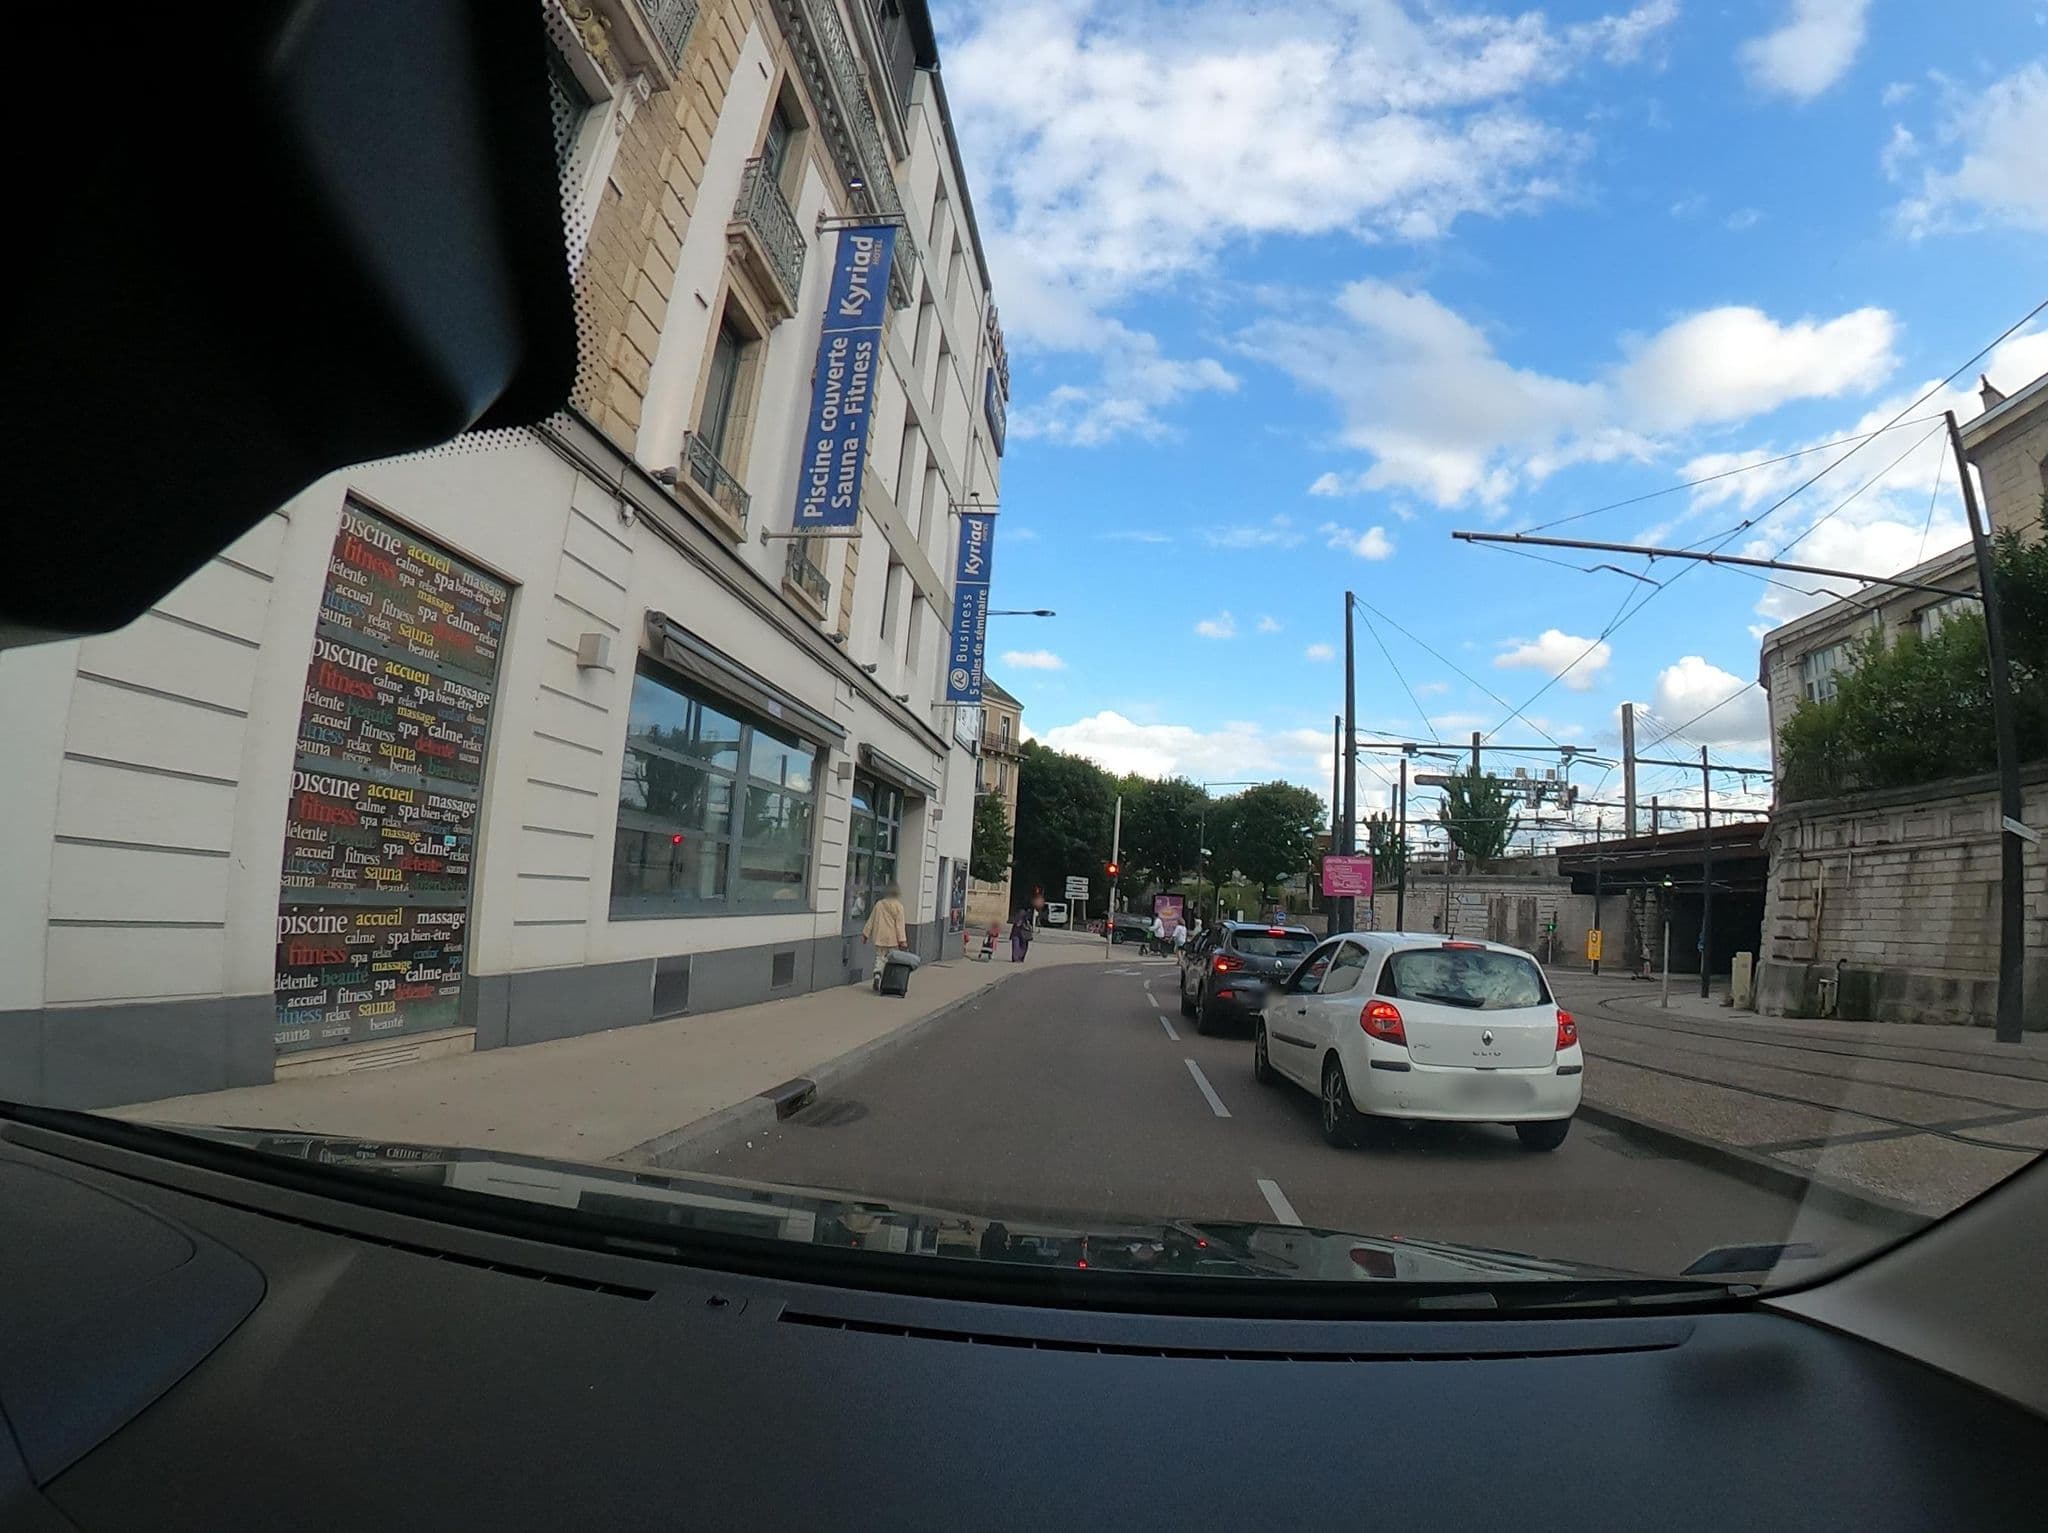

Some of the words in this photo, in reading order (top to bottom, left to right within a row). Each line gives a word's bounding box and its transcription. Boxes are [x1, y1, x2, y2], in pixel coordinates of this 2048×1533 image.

[840, 235, 874, 315] Kyriad
[844, 341, 873, 415] Fitness
[803, 438, 833, 518] Piscine
[821, 336, 849, 432] couverte
[831, 437, 860, 509] Sauna
[964, 519, 984, 575] Kyriad
[395, 557, 424, 577] calme
[407, 545, 451, 574] accueil
[399, 571, 416, 587] spa
[434, 572, 455, 592] spa
[463, 572, 507, 604] massage
[336, 583, 374, 606] accueil
[456, 577, 491, 607] bien-être
[382, 598, 415, 625] fitness
[417, 590, 455, 614] massage
[367, 613, 392, 632] relax
[418, 605, 438, 622] spa
[974, 589, 987, 641] séminaire
[447, 612, 480, 636] calme
[956, 594, 973, 662] Business
[398, 623, 434, 647] sauna
[408, 639, 440, 661] beauté
[973, 643, 983, 656] de
[319, 662, 374, 700] fitness
[385, 661, 430, 685] accueil
[971, 658, 981, 687] salles
[373, 674, 404, 692] calme
[969, 688, 979, 696] 5
[377, 691, 394, 706] spa
[414, 686, 435, 704] spa
[436, 688, 474, 712] bien-être
[443, 680, 490, 708] massage
[311, 713, 352, 731] accueil
[397, 706, 436, 727] massage
[360, 720, 396, 743] fitness
[398, 722, 419, 739] spa
[428, 722, 463, 744] calme
[347, 736, 373, 753] relax
[379, 742, 416, 762] sauna
[463, 737, 482, 752] relax
[390, 757, 422, 776] beauté
[289, 770, 360, 800] piscine
[368, 784, 414, 803] accueil
[356, 798, 386, 814] calme
[398, 804, 419, 823] spa
[420, 804, 460, 823] bien-être
[429, 795, 476, 818] massage
[360, 815, 378, 830] spa
[381, 828, 421, 845] massage
[295, 845, 335, 860] accueil
[345, 846, 380, 866] fitness
[383, 842, 404, 860] spa
[414, 837, 450, 857] calme
[331, 863, 357, 879] relax
[364, 866, 402, 881] sauna
[277, 906, 348, 944] piscine
[355, 907, 402, 926] accueil
[416, 912, 465, 930] massage
[345, 929, 375, 944] calme
[387, 931, 410, 950] spa
[410, 928, 450, 941] bien-être
[289, 941, 348, 965] fitness
[350, 953, 368, 968] spa
[372, 960, 412, 974] massage
[405, 963, 442, 982] calme
[337, 987, 373, 1004] fitness
[375, 979, 396, 996] spa
[288, 989, 327, 1008] accueil
[325, 1006, 351, 1022] relax
[358, 1000, 396, 1017] sauna
